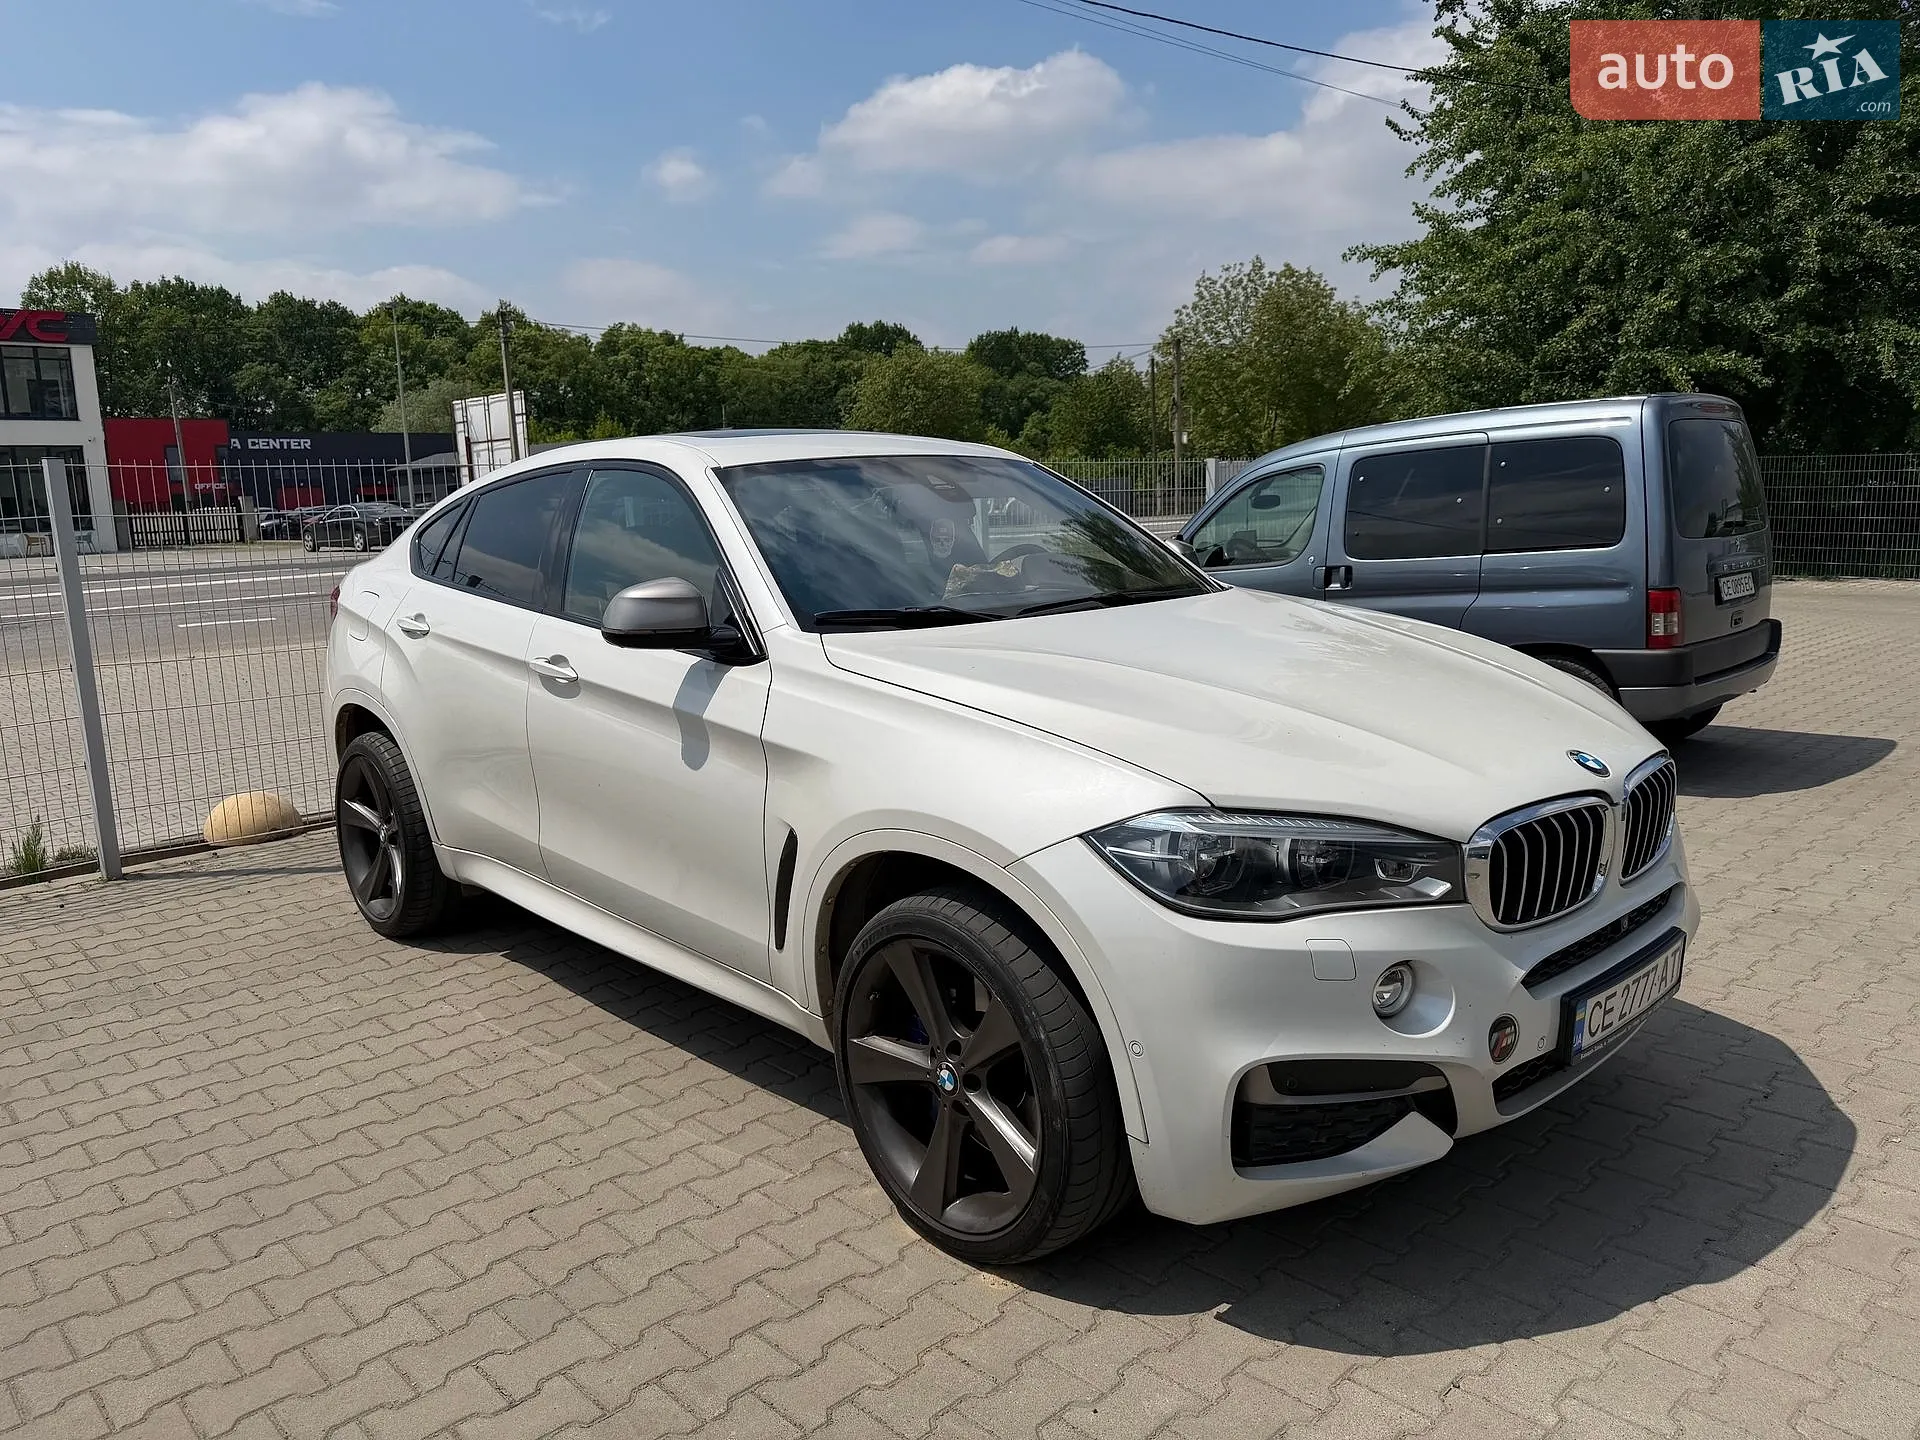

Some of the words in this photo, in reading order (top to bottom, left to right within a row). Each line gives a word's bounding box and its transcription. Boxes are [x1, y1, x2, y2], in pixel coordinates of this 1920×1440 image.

[247, 438, 312, 450] CENTER
[194, 482, 227, 490] OFFICE
[1588, 991, 1616, 1037] CE
[1618, 967, 1658, 1021] 2777
